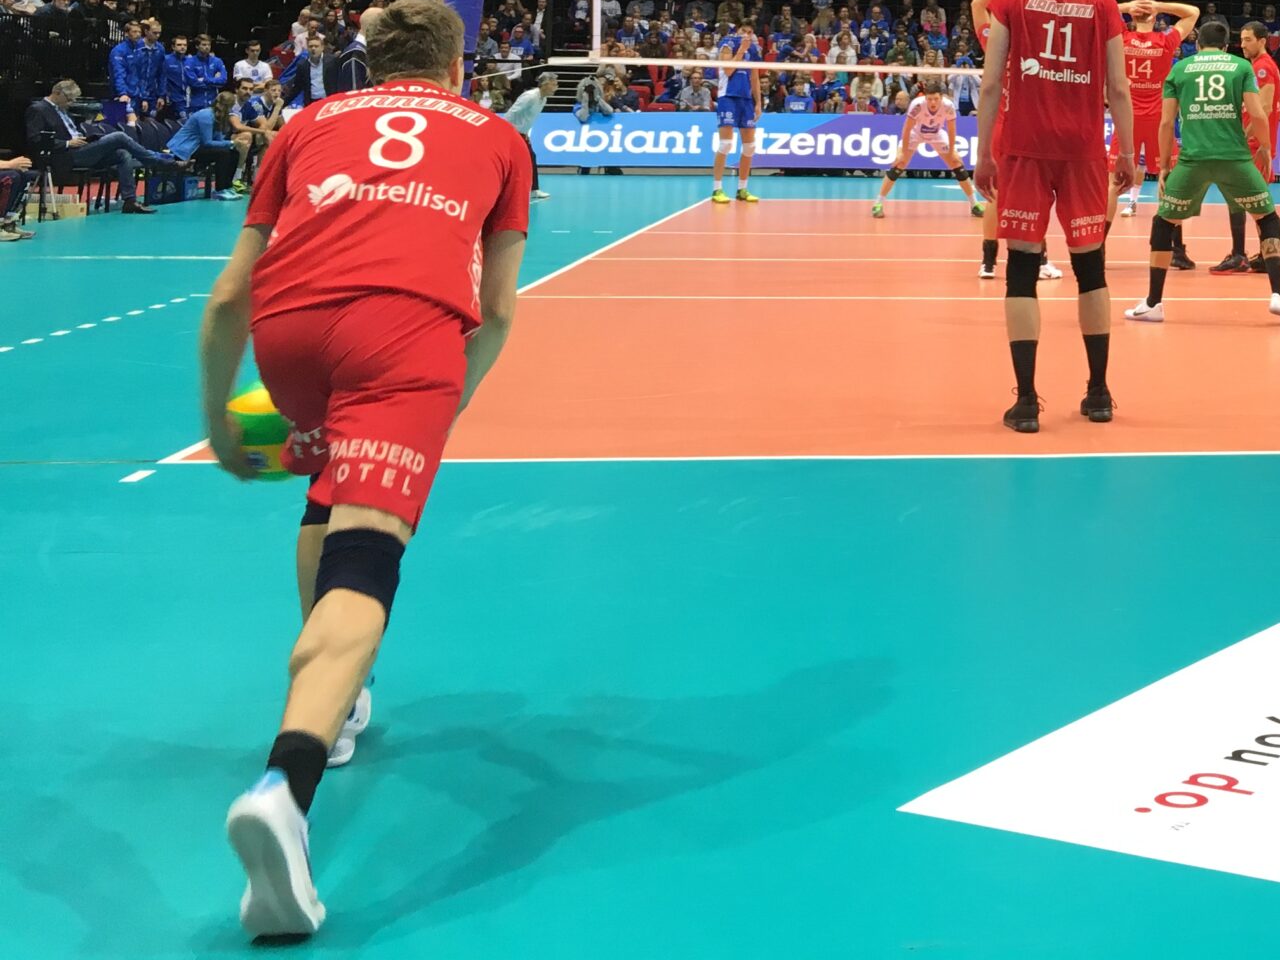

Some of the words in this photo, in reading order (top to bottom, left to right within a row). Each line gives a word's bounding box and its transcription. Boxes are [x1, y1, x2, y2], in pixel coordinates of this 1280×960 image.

[1039, 19, 1077, 62] 11
[1039, 65, 1091, 84] intellisol
[1128, 58, 1152, 79] 14
[1131, 80, 1161, 89] intellisol
[1195, 74, 1226, 101] 18
[368, 111, 427, 169] 8
[543, 123, 703, 154] abiant
[348, 181, 468, 221] intellisol
[1072, 224, 1102, 238] HOTEL
[332, 462, 412, 496] OTEL
[1134, 772, 1254, 813] do.
